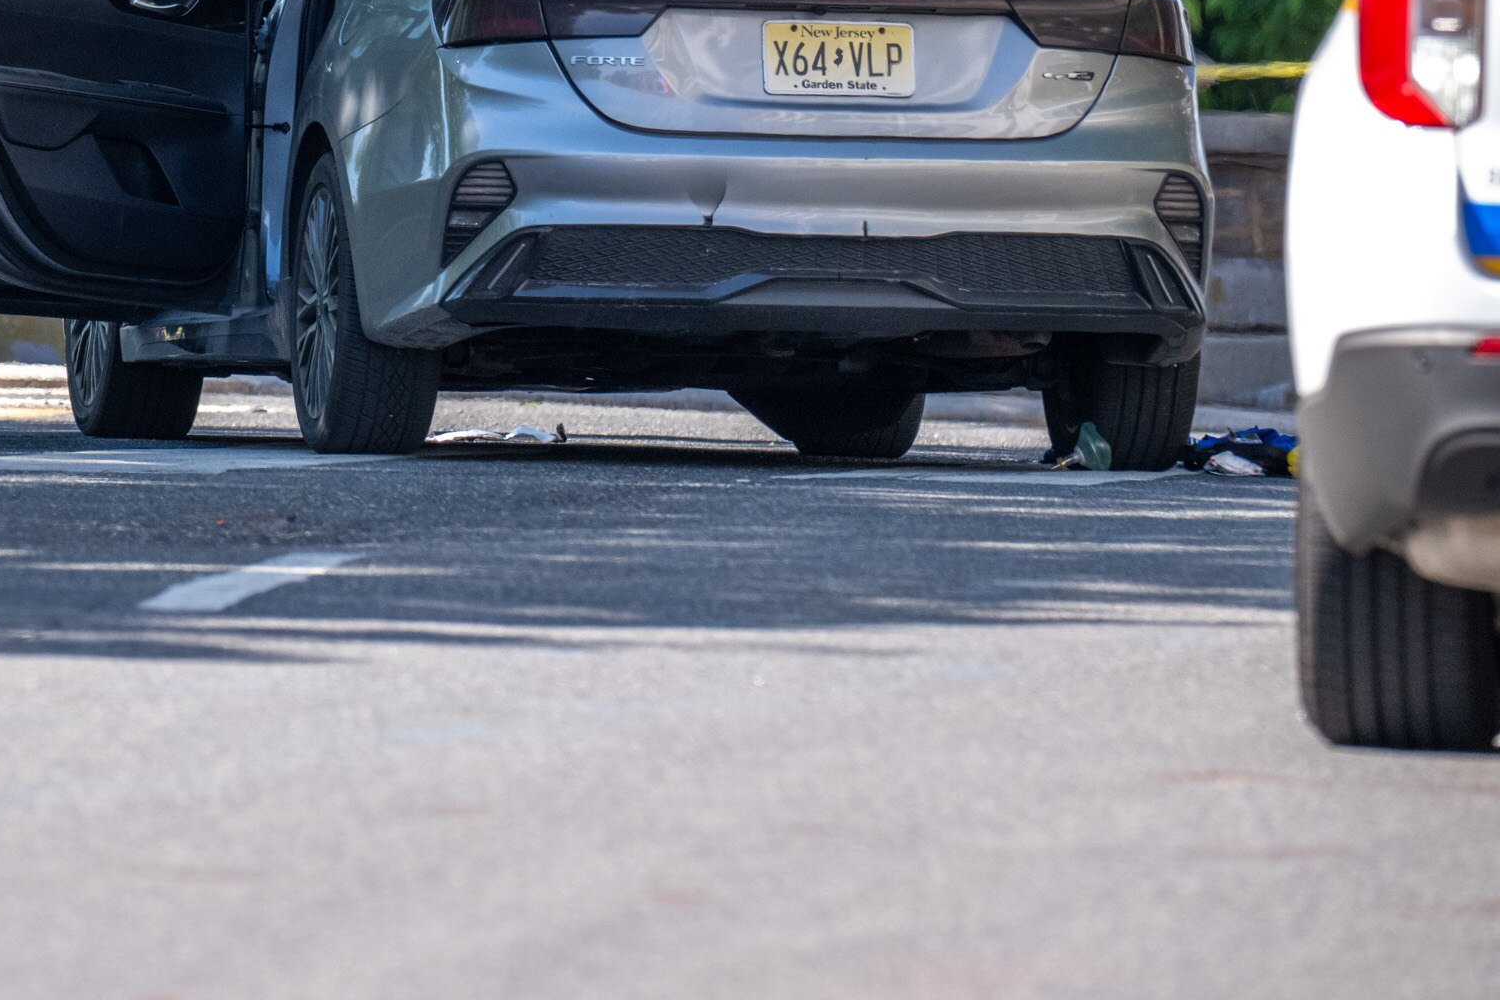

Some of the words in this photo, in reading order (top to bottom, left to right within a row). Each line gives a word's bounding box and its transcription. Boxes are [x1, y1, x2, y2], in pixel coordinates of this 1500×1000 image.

[801, 25, 830, 38] New
[834, 26, 876, 41] Jersey
[570, 55, 645, 66] FORTE
[773, 41, 827, 76] X64
[849, 41, 903, 77] VLP
[801, 79, 843, 90] Garden
[847, 80, 878, 91] State
